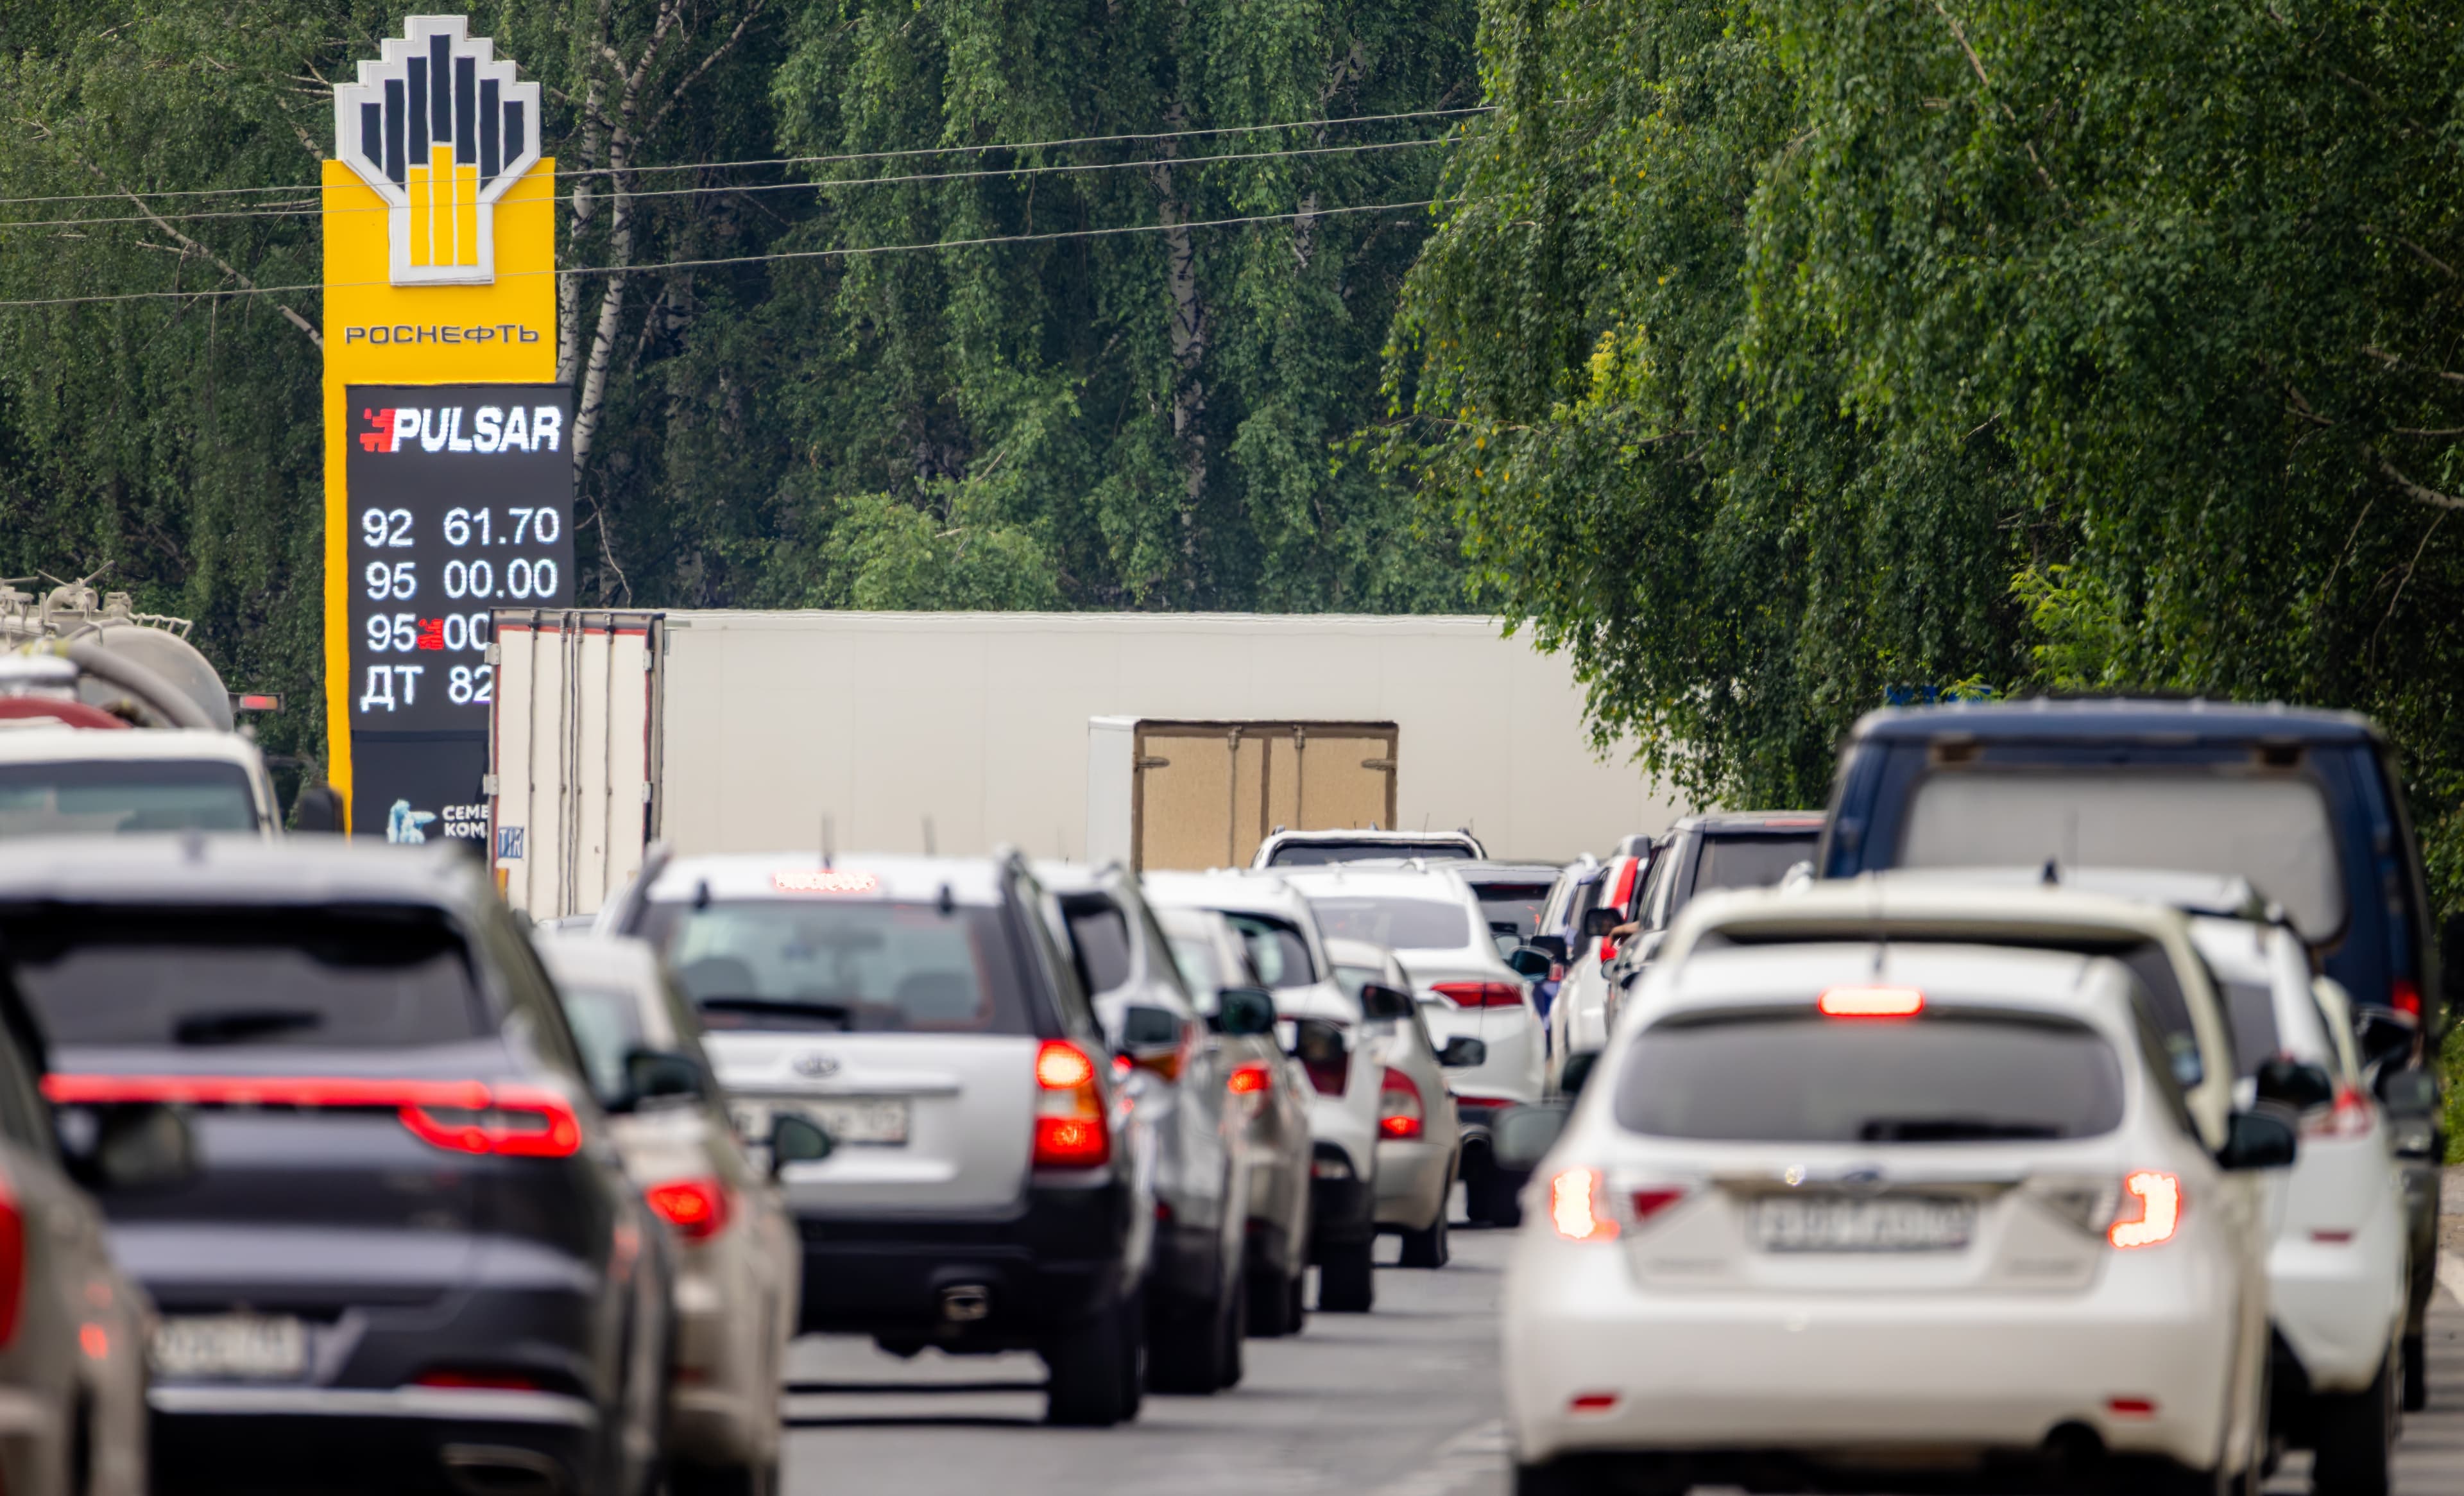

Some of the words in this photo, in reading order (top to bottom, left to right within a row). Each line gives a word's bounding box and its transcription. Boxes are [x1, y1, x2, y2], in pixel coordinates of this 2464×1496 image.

[345, 324, 540, 345] РОСНЕФТЬ
[391, 405, 562, 454] PULSAR
[362, 507, 415, 547] 92
[443, 506, 560, 546] 61.70
[365, 560, 416, 600] 95
[443, 558, 558, 599] 00.00
[366, 613, 417, 652] 95
[360, 664, 424, 714] ДТ
[444, 821, 488, 839] КОМ
[499, 829, 522, 857] TIR
